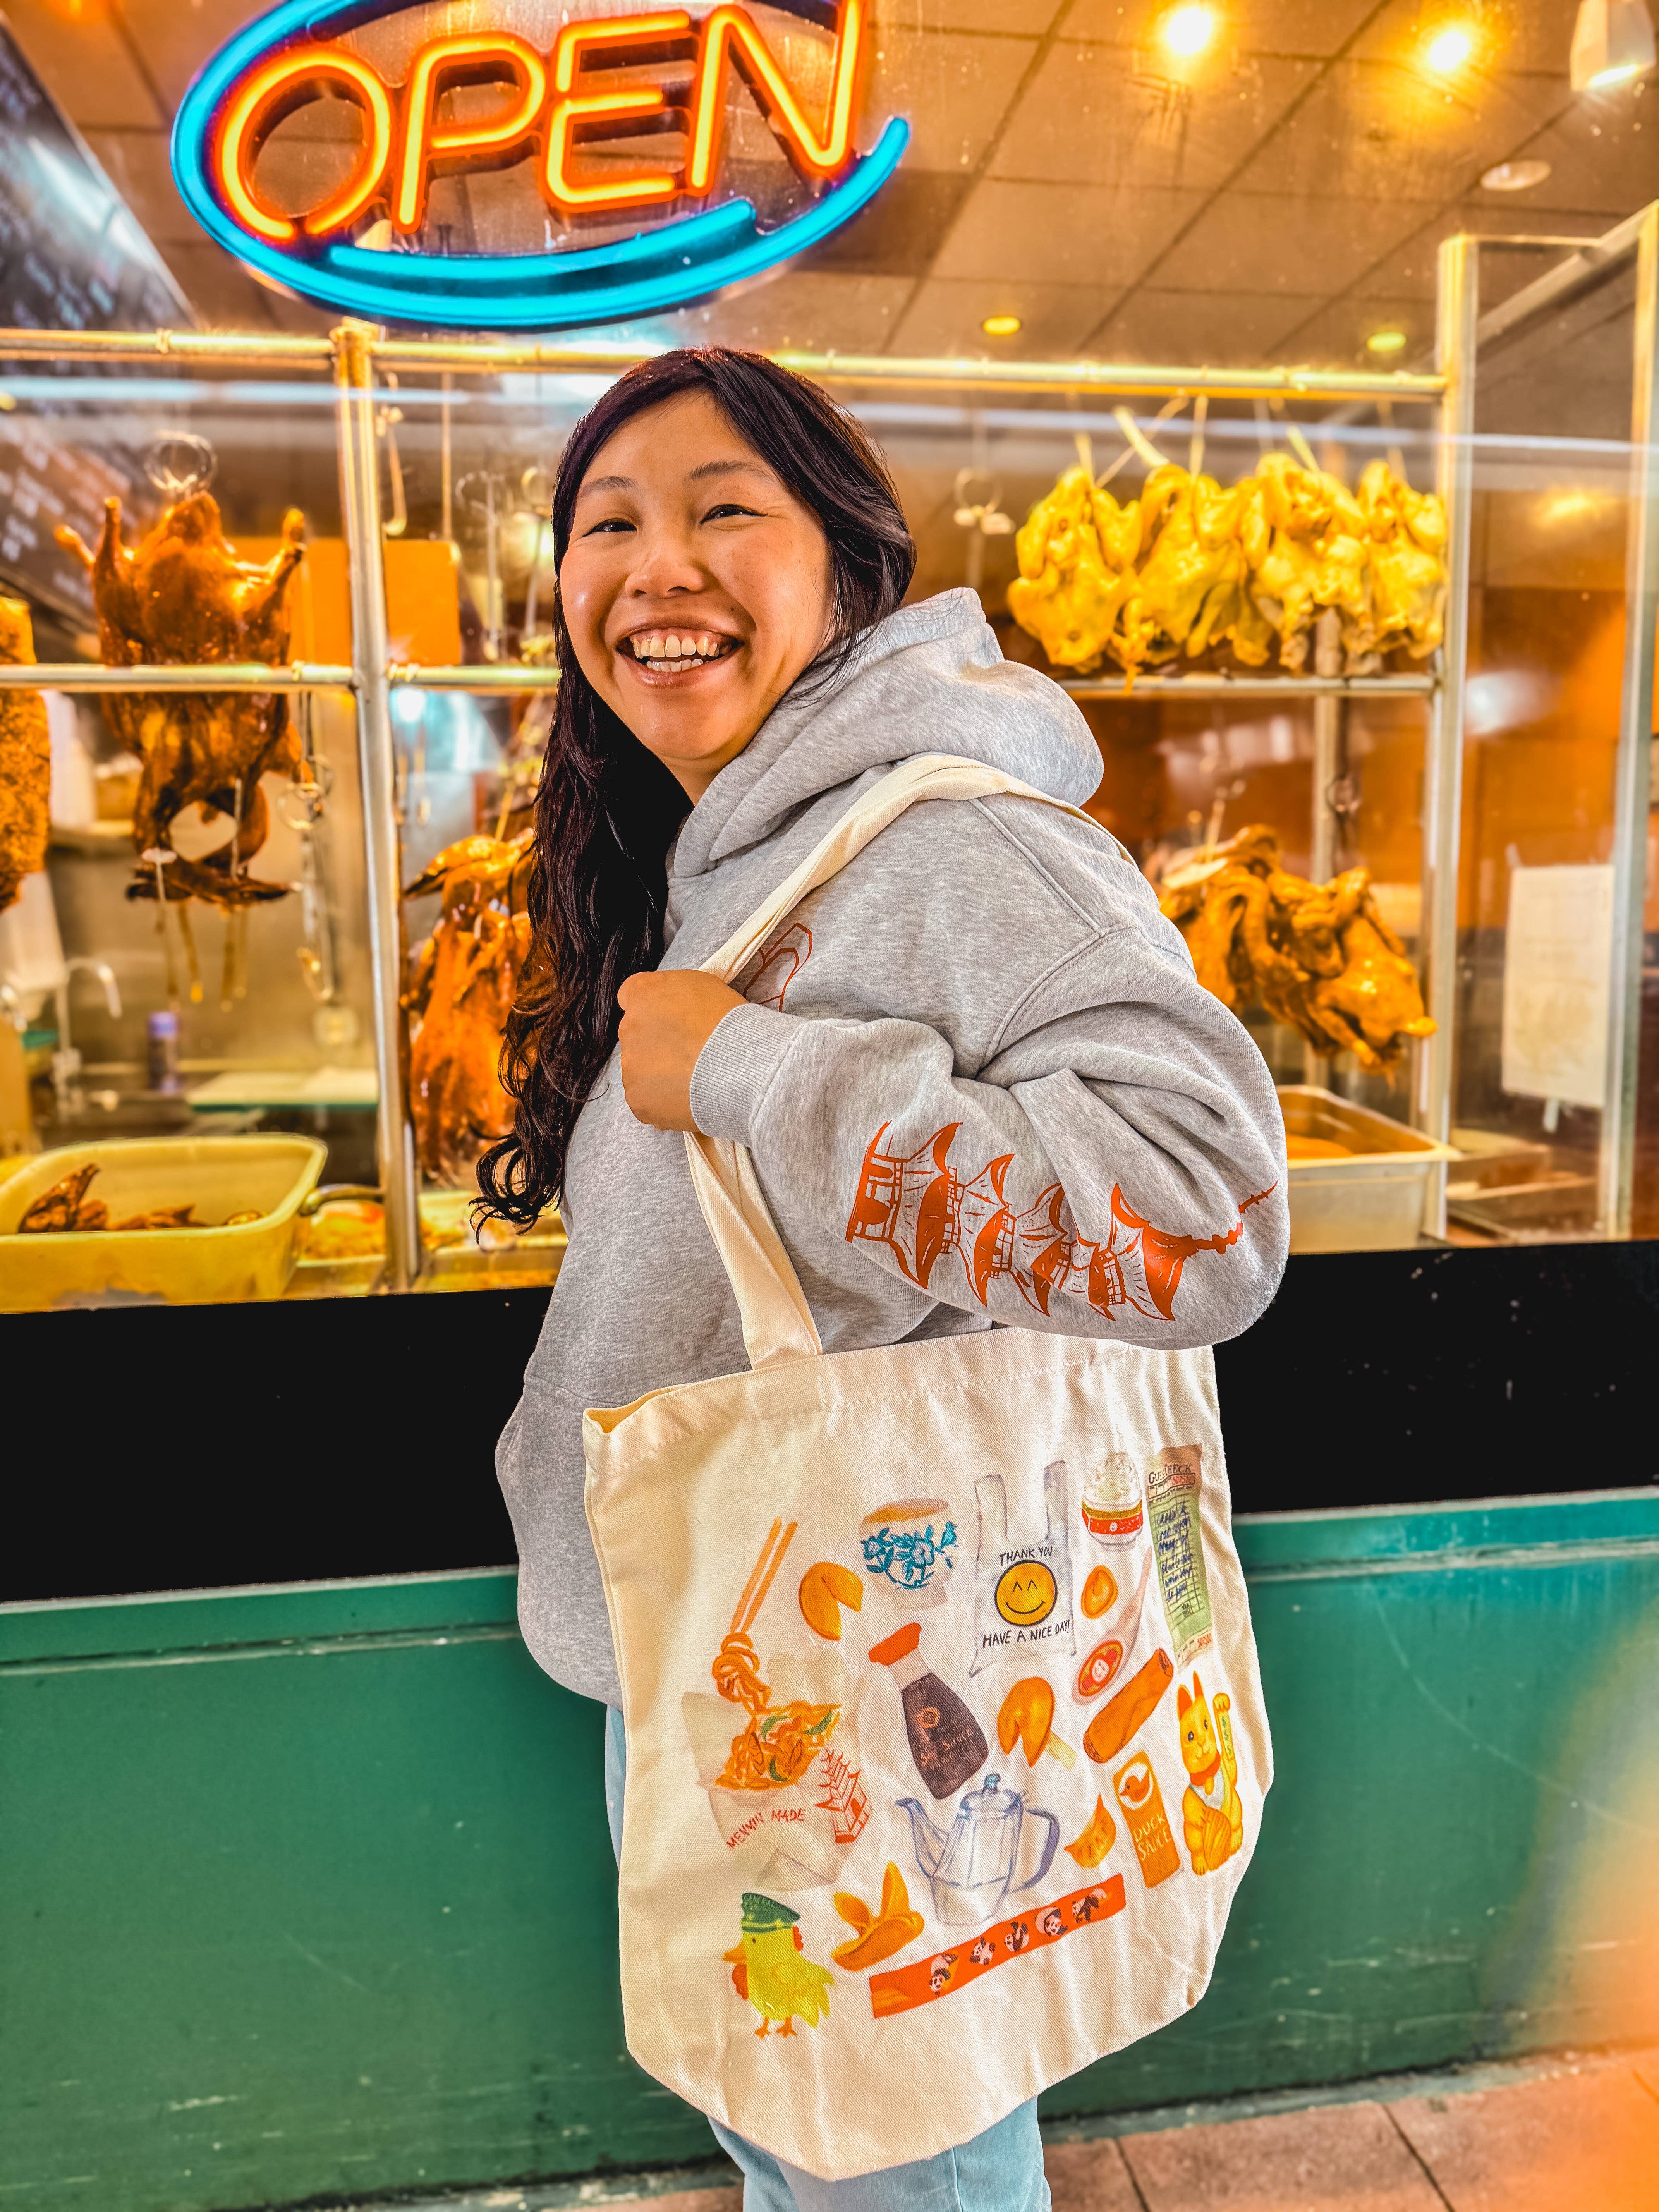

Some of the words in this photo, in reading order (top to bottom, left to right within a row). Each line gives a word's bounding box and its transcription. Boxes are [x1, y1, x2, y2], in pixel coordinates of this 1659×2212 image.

[217, 0, 864, 239] OPEN
[999, 1548, 1036, 1566] THANK
[1038, 1546, 1053, 1557] YOU
[983, 1630, 1011, 1648] HAVE
[1017, 1630, 1026, 1642] A
[1030, 1626, 1052, 1641] NICE
[1133, 1812, 1165, 1843] DUCK
